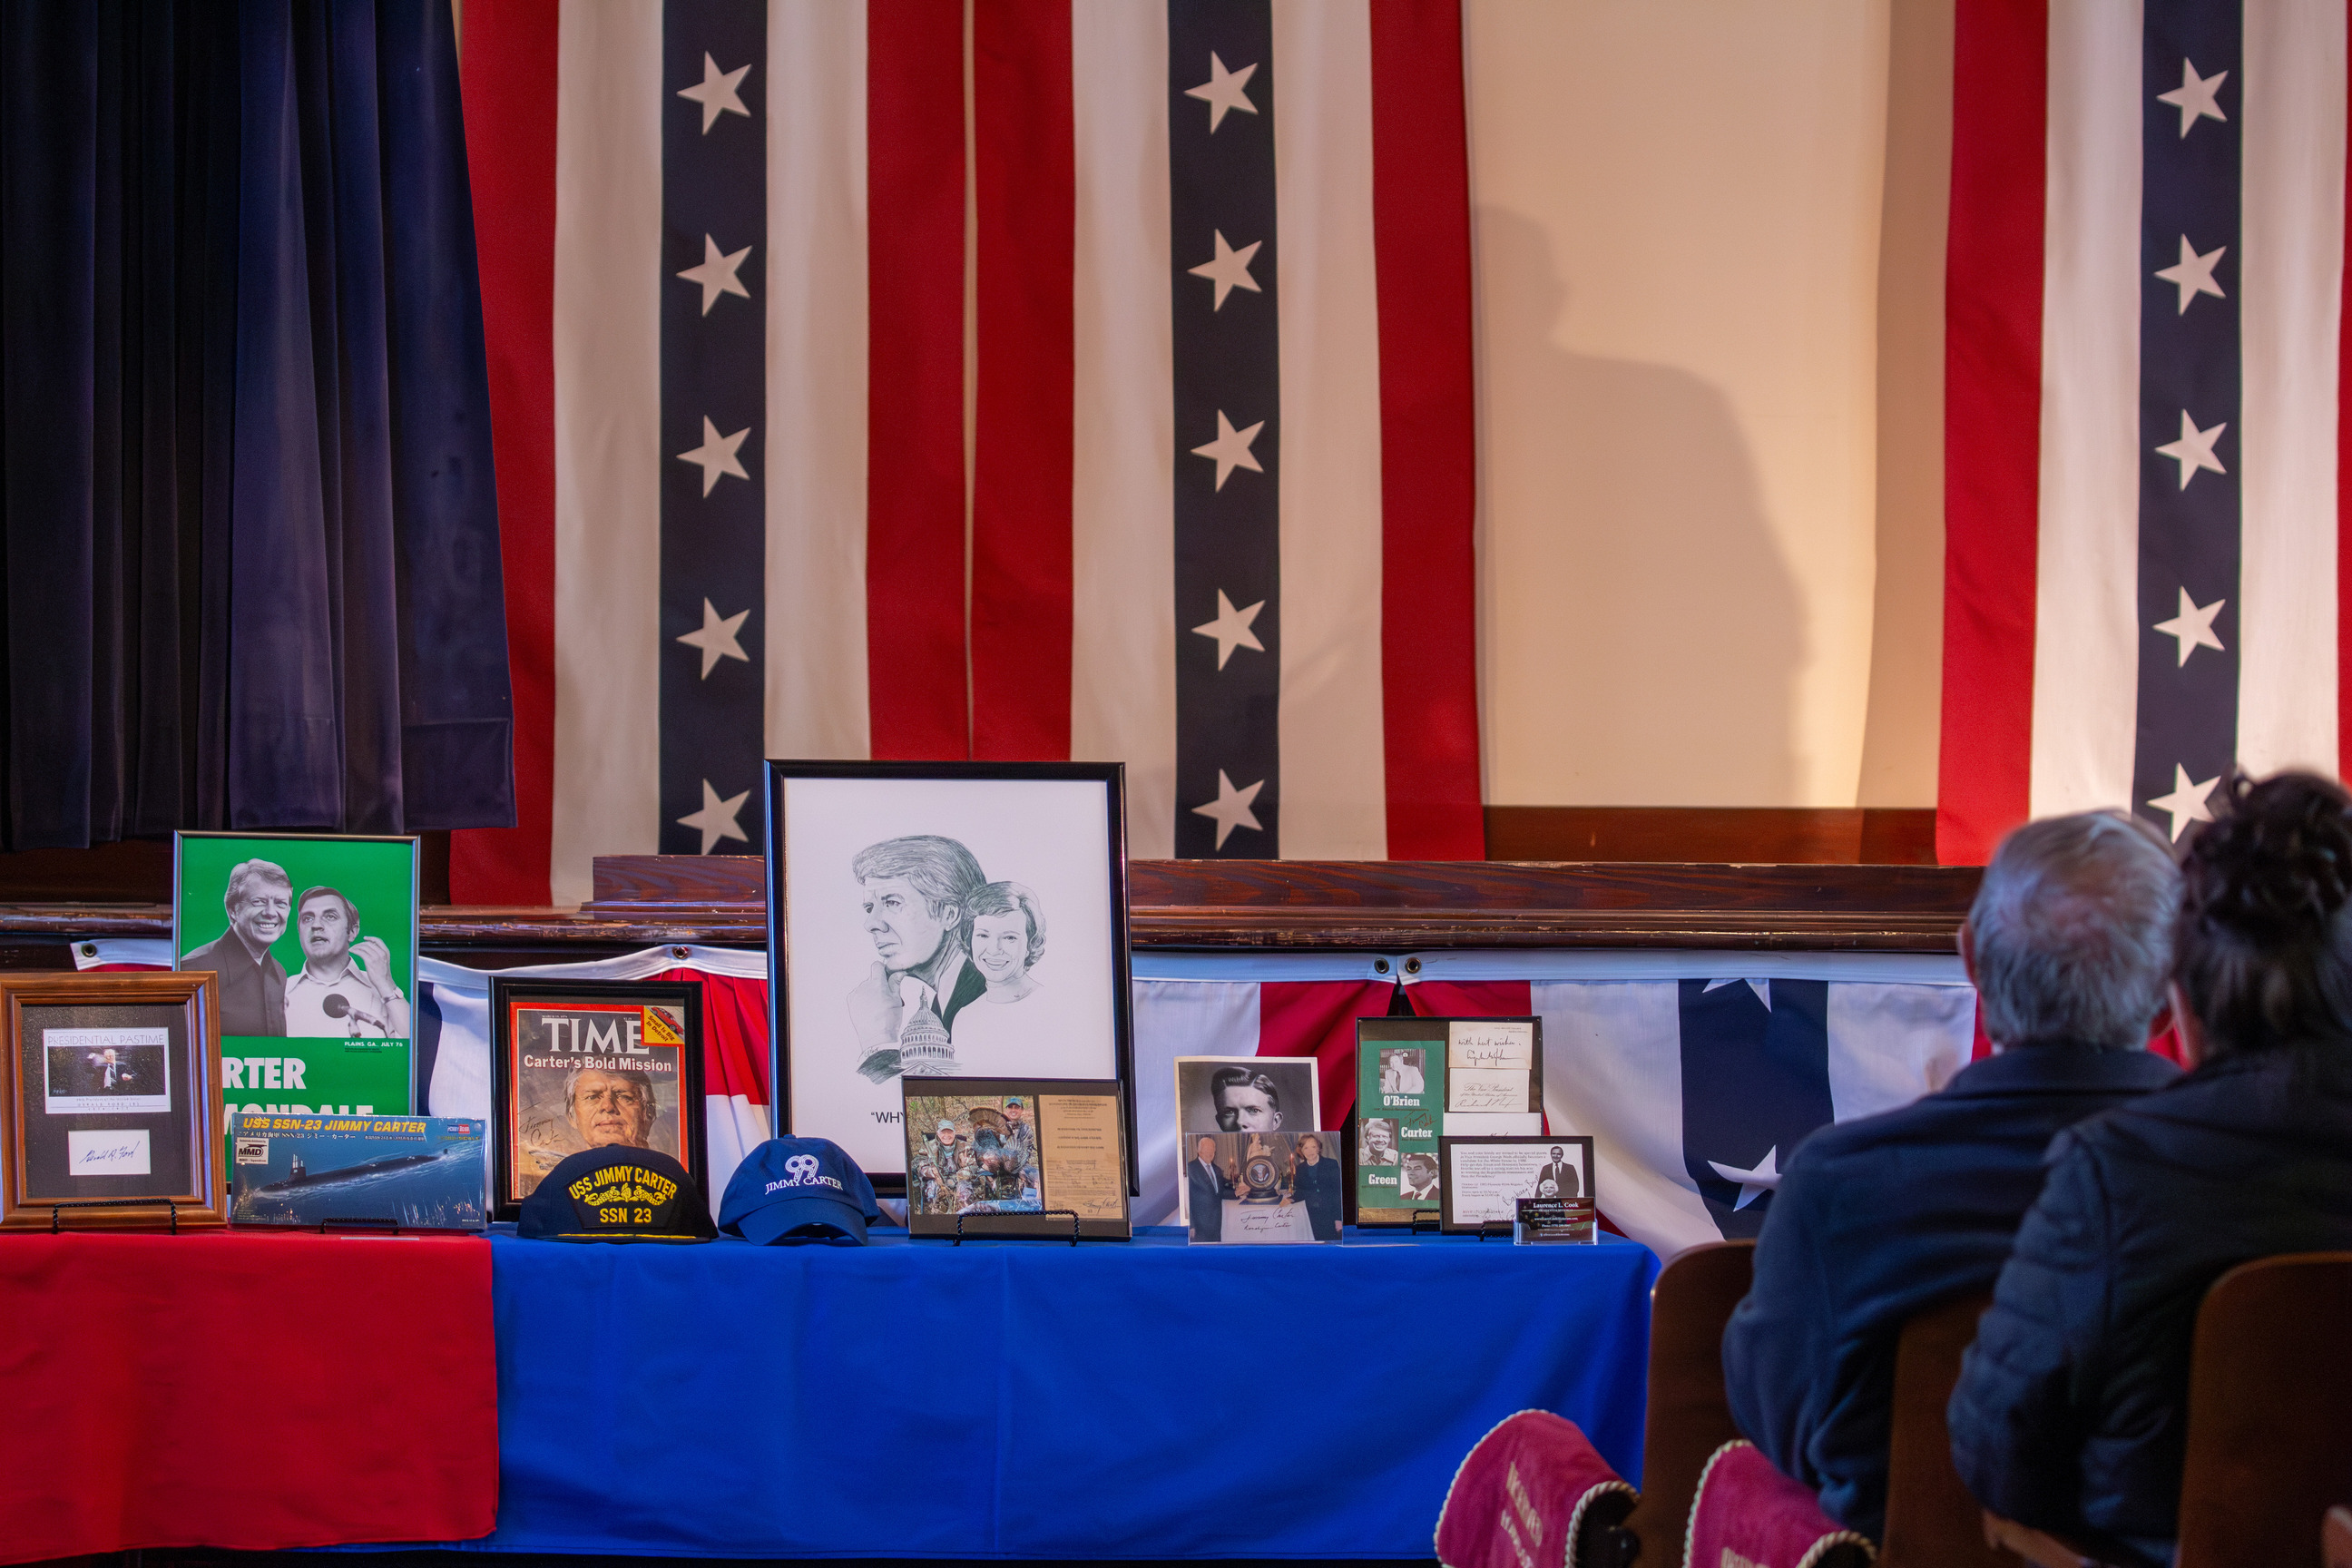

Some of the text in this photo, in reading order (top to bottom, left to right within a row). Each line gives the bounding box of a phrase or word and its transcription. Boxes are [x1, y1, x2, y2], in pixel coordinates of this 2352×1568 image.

[648, 1015, 662, 1028] Small
[47, 1034, 164, 1045] PRESIDENTIAL PASTIME
[542, 1017, 650, 1054] TIME
[652, 1025, 669, 1042] Detroit
[524, 1054, 672, 1072] Carter's Bold Mission
[1383, 1095, 1420, 1106] O'Brien
[871, 1112, 904, 1123] “WH
[243, 1118, 426, 1132] USS SSN-23 JIMMY CARTER
[1401, 1127, 1433, 1138] Carter
[238, 1147, 262, 1156] MMD
[569, 1166, 677, 1200] USS JIMMY CARTER
[765, 1176, 843, 1195] JIMMY CARTER
[1368, 1174, 1397, 1185] Green
[600, 1208, 652, 1223] SSN 23
